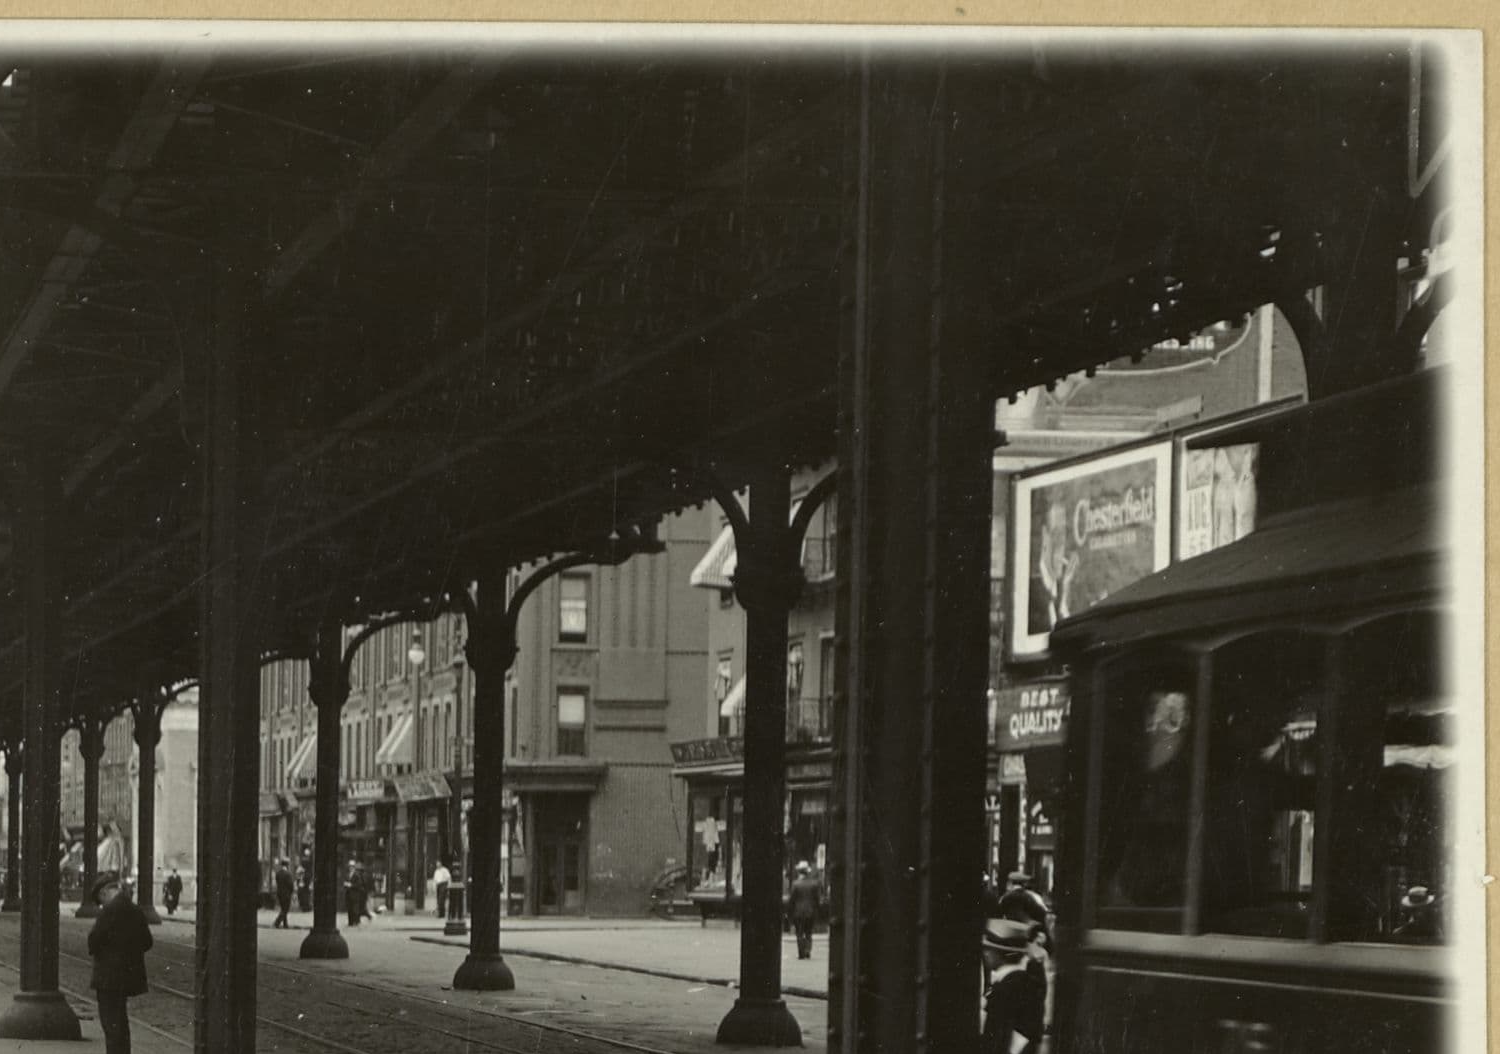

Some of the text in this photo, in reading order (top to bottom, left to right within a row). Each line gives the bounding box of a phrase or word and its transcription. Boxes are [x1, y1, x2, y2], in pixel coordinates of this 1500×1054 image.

[1073, 486, 1155, 547] Chesterfield
[1020, 688, 1059, 708] BEST
[1009, 708, 1063, 739] QUALITY
